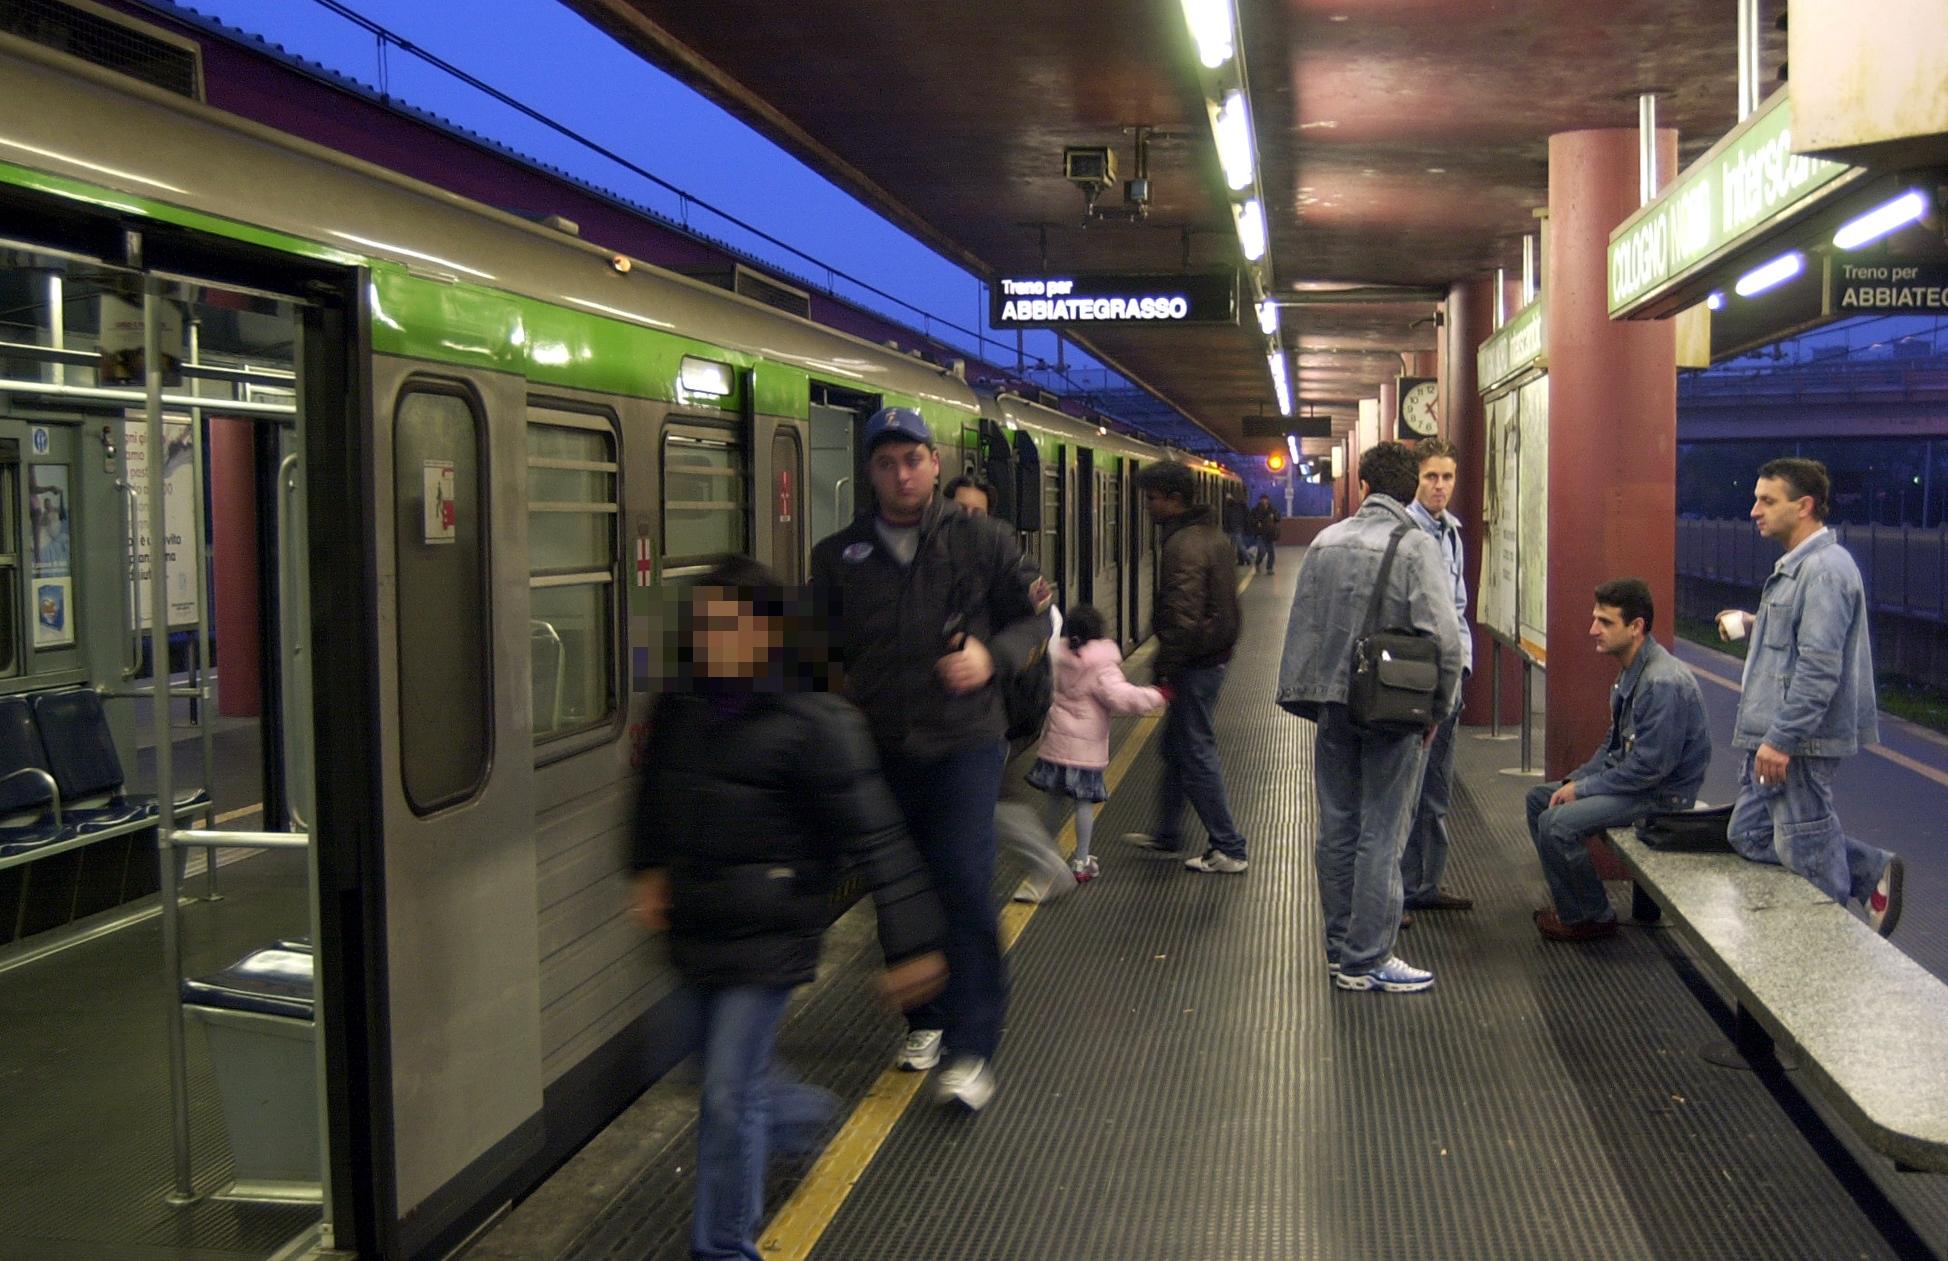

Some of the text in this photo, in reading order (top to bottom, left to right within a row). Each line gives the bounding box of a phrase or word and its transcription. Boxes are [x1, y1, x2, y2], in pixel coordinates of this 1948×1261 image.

[1612, 213, 1667, 303] COLOGNO
[1842, 264, 1918, 282] Treno per
[1001, 280, 1073, 297] Treno per
[1001, 297, 1187, 320] ABBIATEGRASSO
